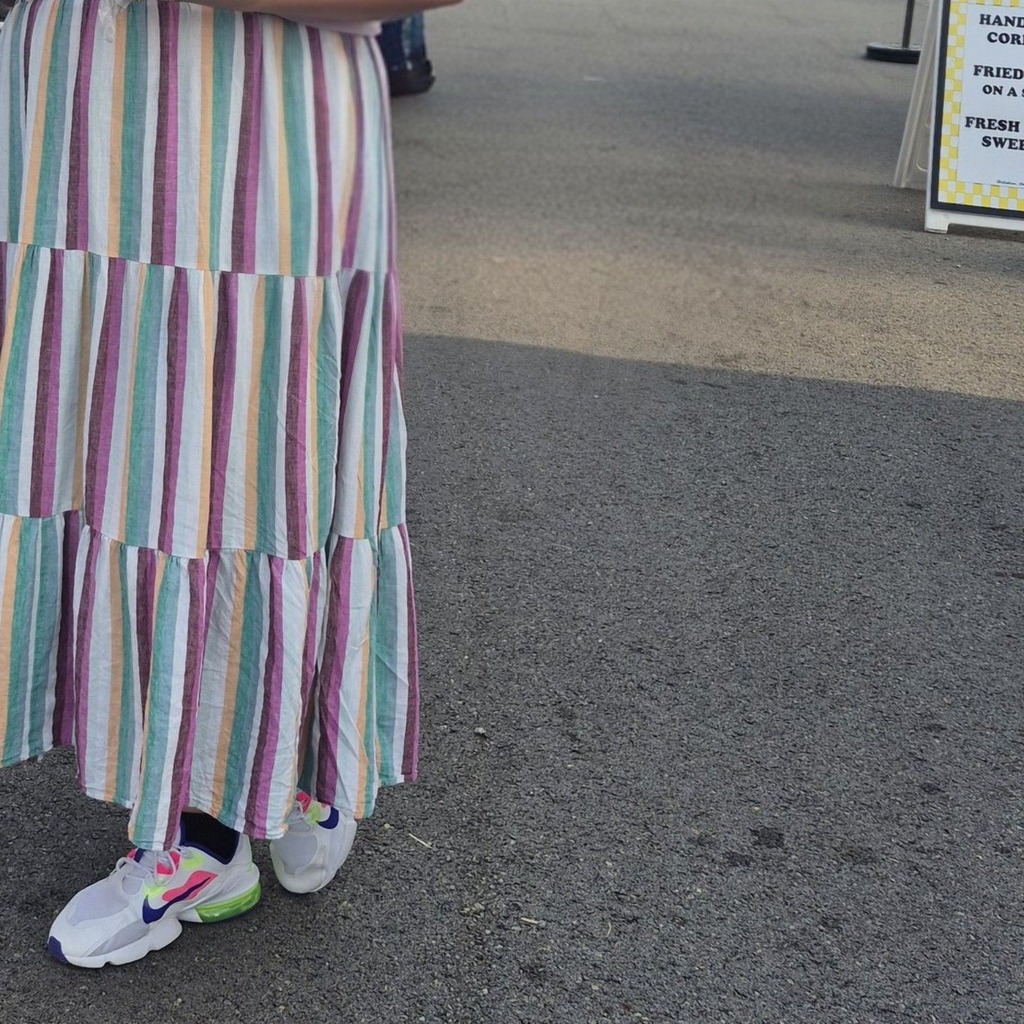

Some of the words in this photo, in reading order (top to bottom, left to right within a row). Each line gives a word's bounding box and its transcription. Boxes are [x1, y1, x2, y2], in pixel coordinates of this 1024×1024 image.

[987, 32, 1024, 46] COR
[973, 64, 1024, 80] FRIED
[982, 84, 1004, 95] ON
[1007, 86, 1018, 97] A
[965, 116, 1020, 132] FRESH
